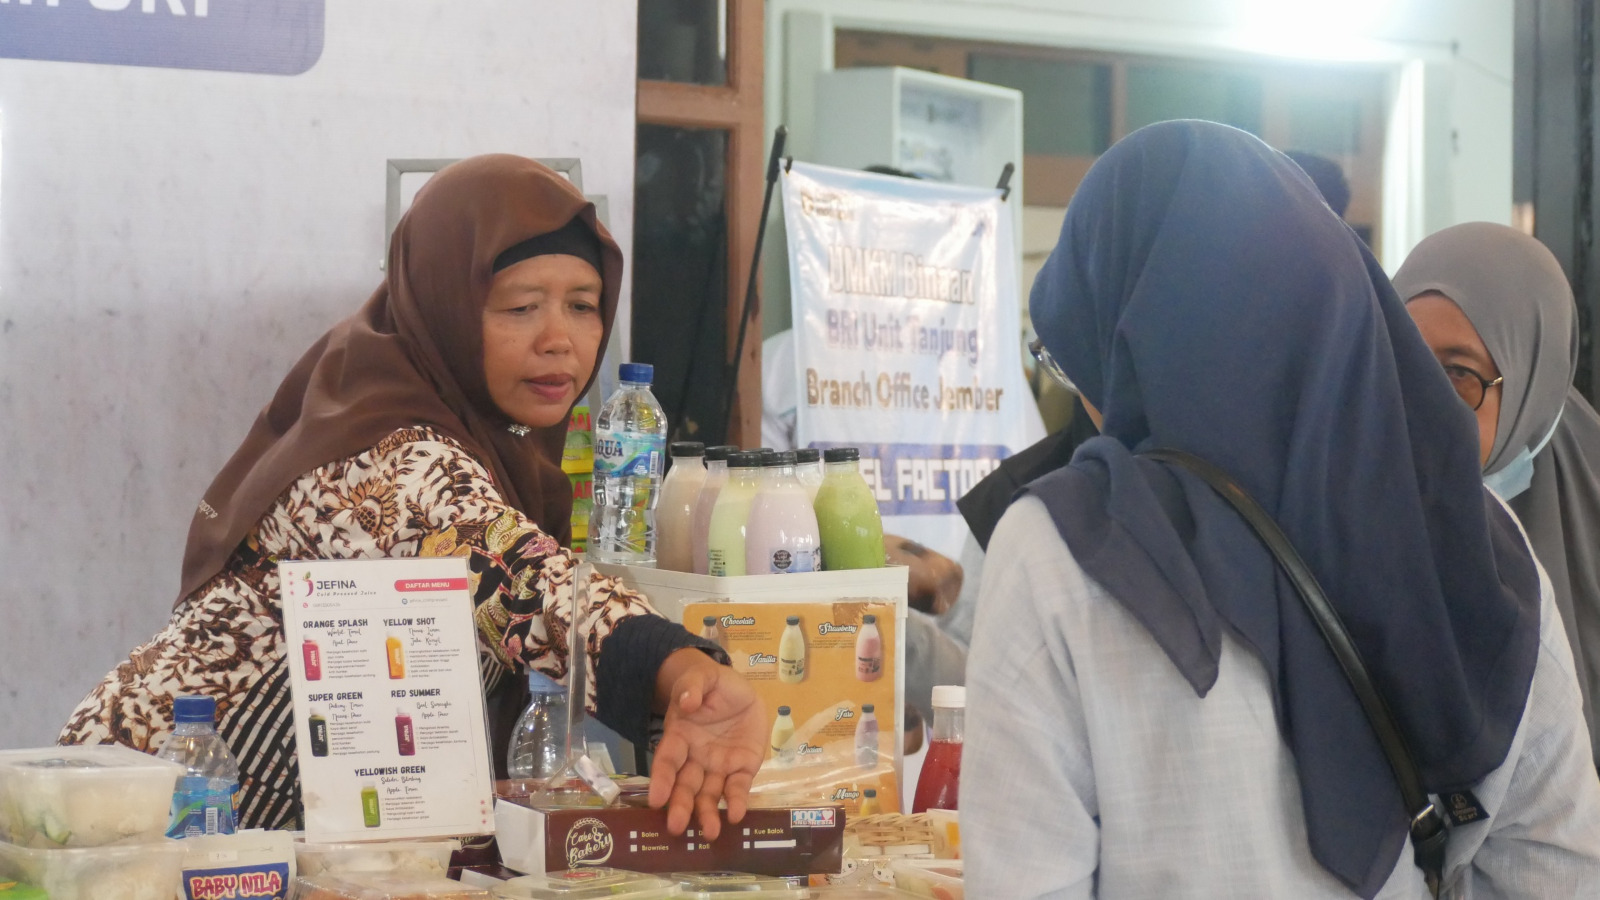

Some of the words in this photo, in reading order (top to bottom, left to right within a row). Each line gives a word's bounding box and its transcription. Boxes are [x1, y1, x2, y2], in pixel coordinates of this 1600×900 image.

[828, 244, 897, 297] UMKM
[902, 251, 975, 304] Binaan
[826, 309, 859, 347] BRI
[864, 312, 905, 349] Unit
[907, 315, 979, 366] Tanjung
[807, 368, 873, 407] Branch
[876, 371, 930, 410] Office
[934, 376, 1004, 411] Jember
[896, 458, 1002, 501] FACTOR
[316, 580, 357, 590] JEFINA
[303, 620, 335, 629] ORANGE
[338, 619, 368, 628] SPLASH
[383, 619, 413, 627] YELLOW
[416, 617, 436, 626] SHOT
[720, 613, 755, 628] Chocolate
[749, 652, 778, 666] Vanilla
[308, 693, 334, 702] SUPER
[336, 692, 363, 700] GREEN
[409, 688, 441, 697] SUMMER
[835, 706, 855, 721] Taro
[354, 767, 398, 777] YELLOWISH
[400, 765, 426, 774] GREEN
[830, 787, 860, 801] Mango
[570, 831, 593, 846] Cake
[569, 832, 612, 867] Bakery
[192, 874, 237, 898] BABY
[239, 872, 282, 896] NILA
